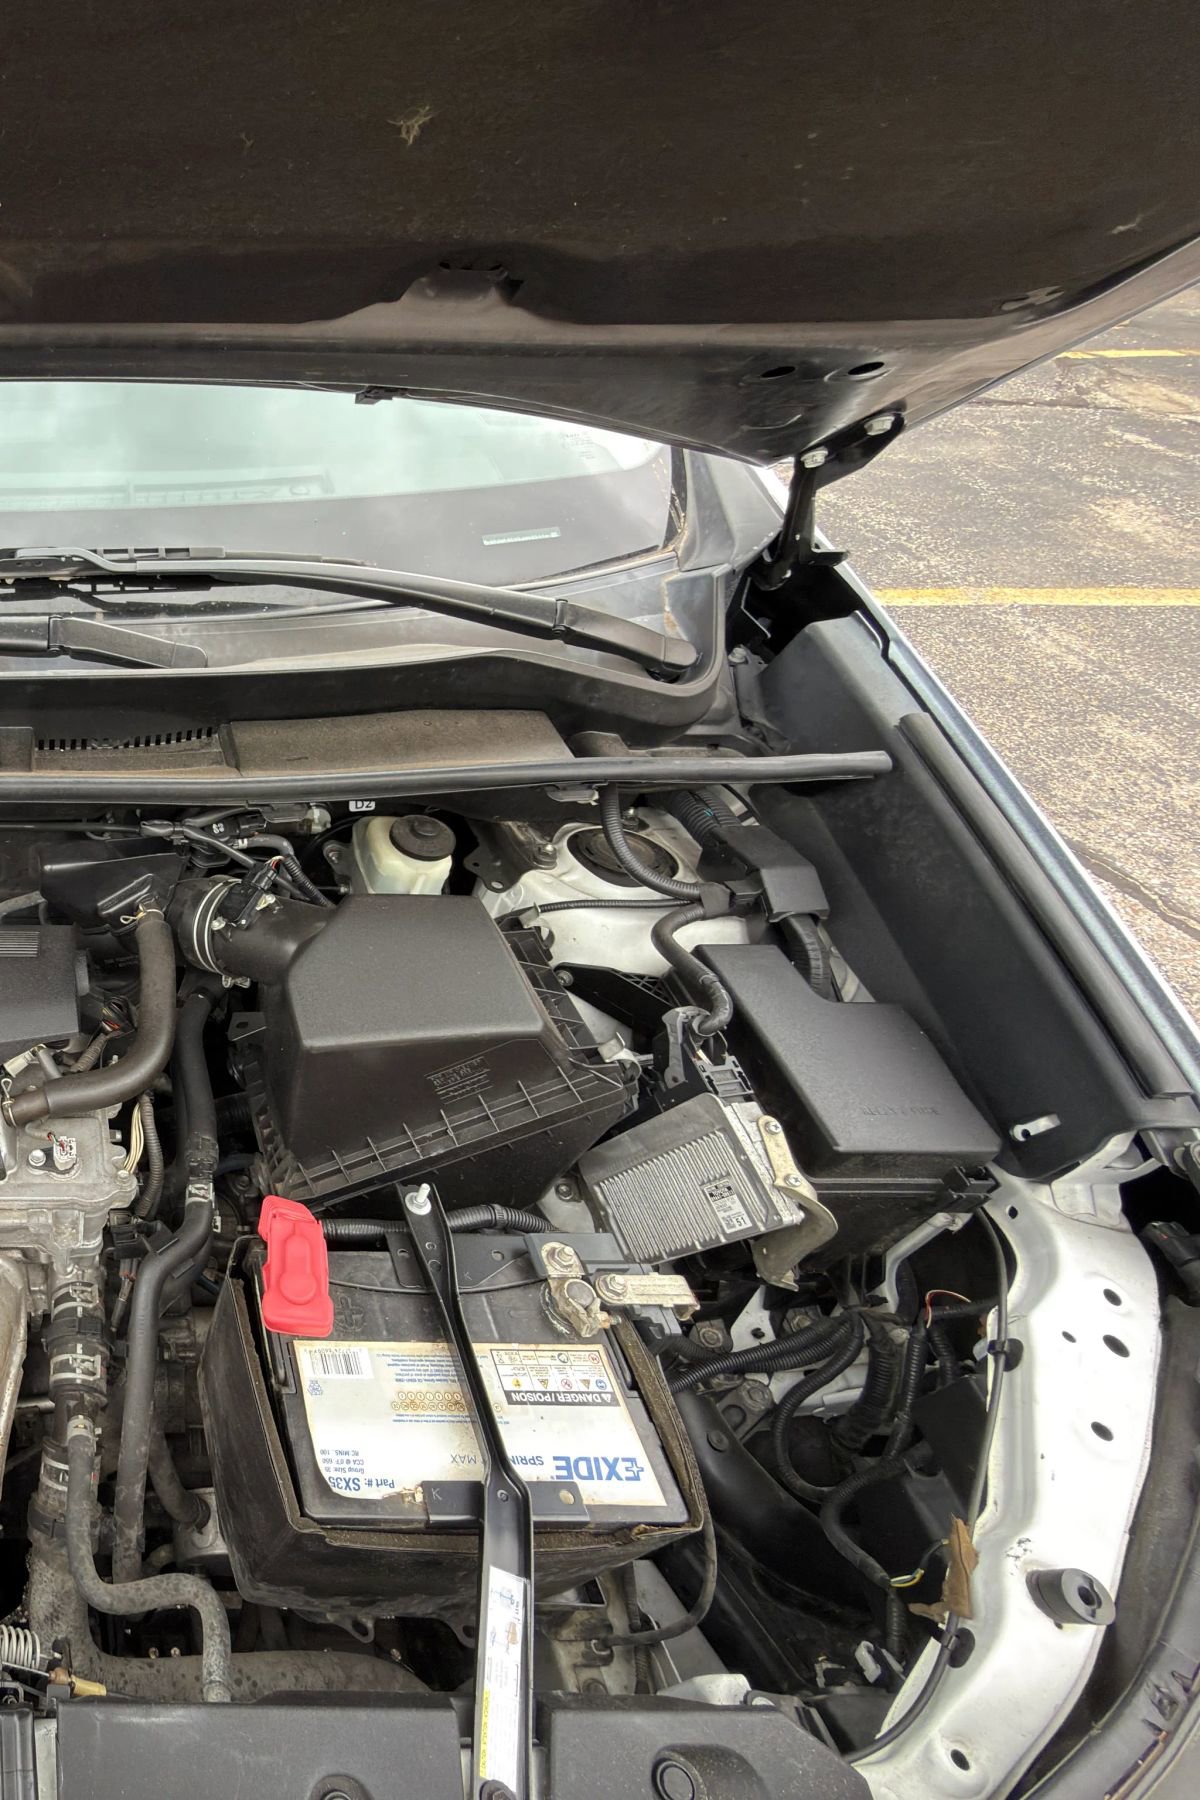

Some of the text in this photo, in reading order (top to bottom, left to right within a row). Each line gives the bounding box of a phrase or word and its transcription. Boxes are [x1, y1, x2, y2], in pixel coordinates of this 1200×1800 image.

[736, 1217, 746, 1226] 51
[450, 1454, 477, 1465] MAX
[552, 1456, 645, 1482] EXIDE
[328, 1476, 361, 1491] SX35
[375, 1478, 395, 1489] Part
